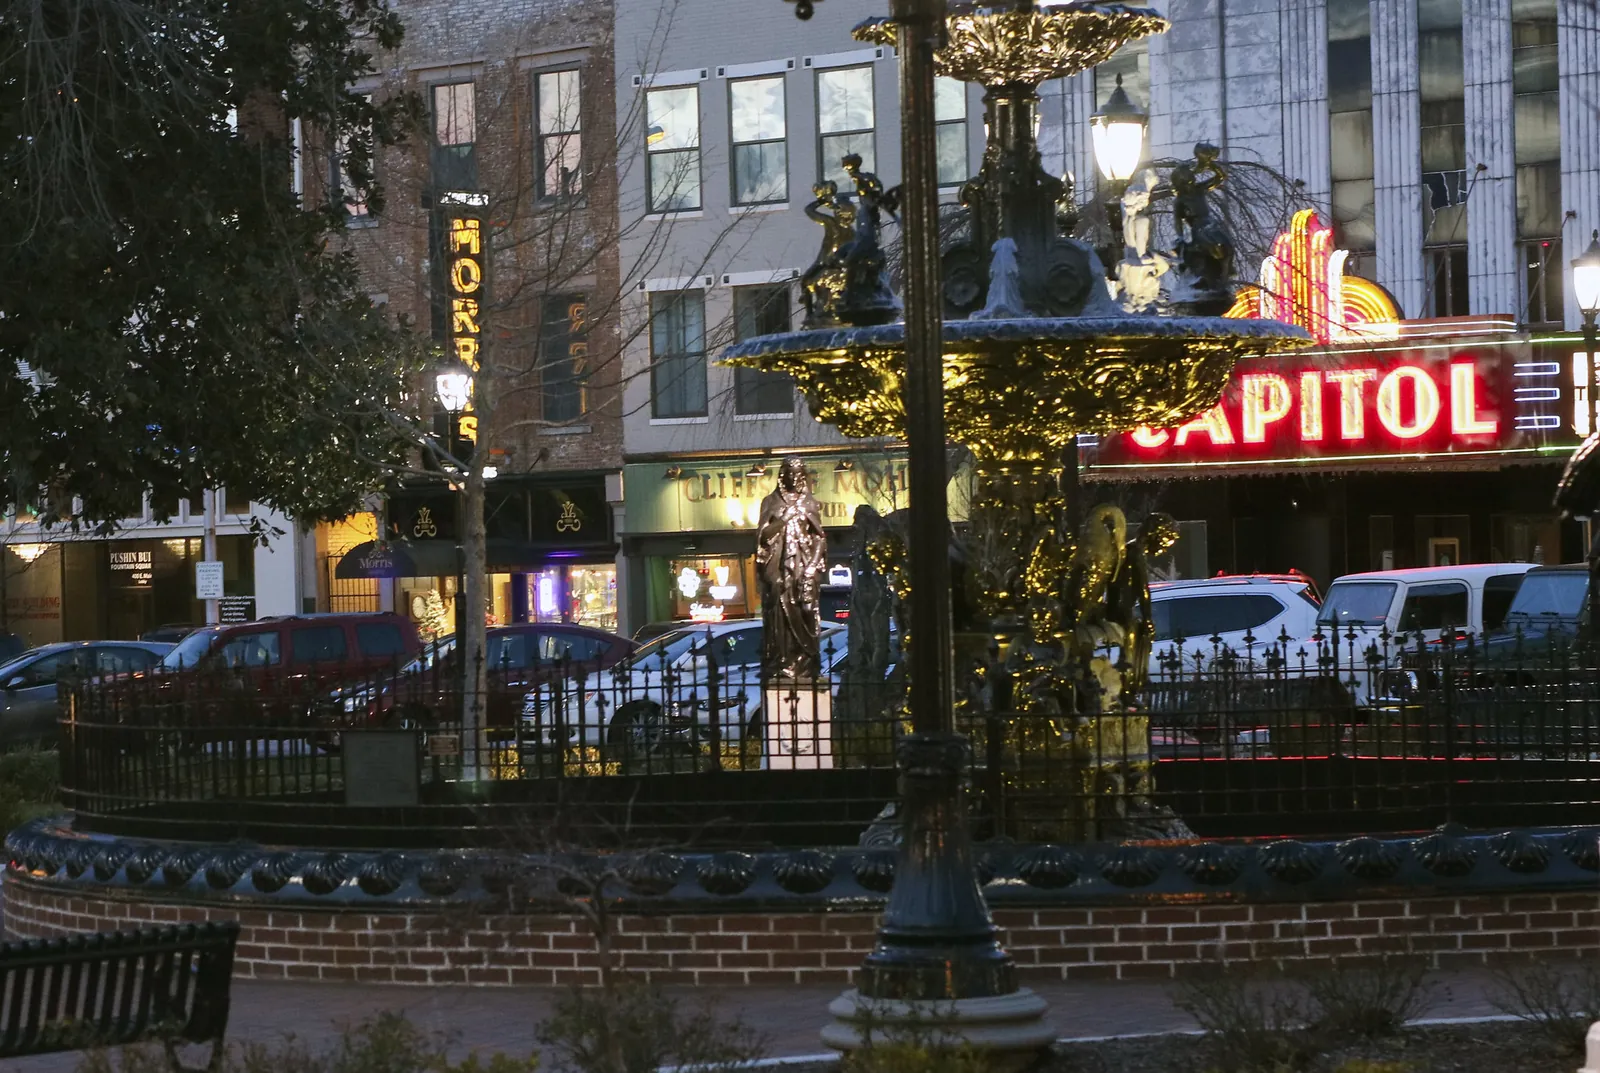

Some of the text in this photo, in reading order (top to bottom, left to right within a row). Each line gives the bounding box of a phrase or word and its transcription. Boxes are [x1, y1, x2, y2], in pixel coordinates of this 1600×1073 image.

[682, 468, 774, 503] CLIFFS
[110, 551, 137, 563] PUSHIN
[358, 557, 393, 569] Morris
